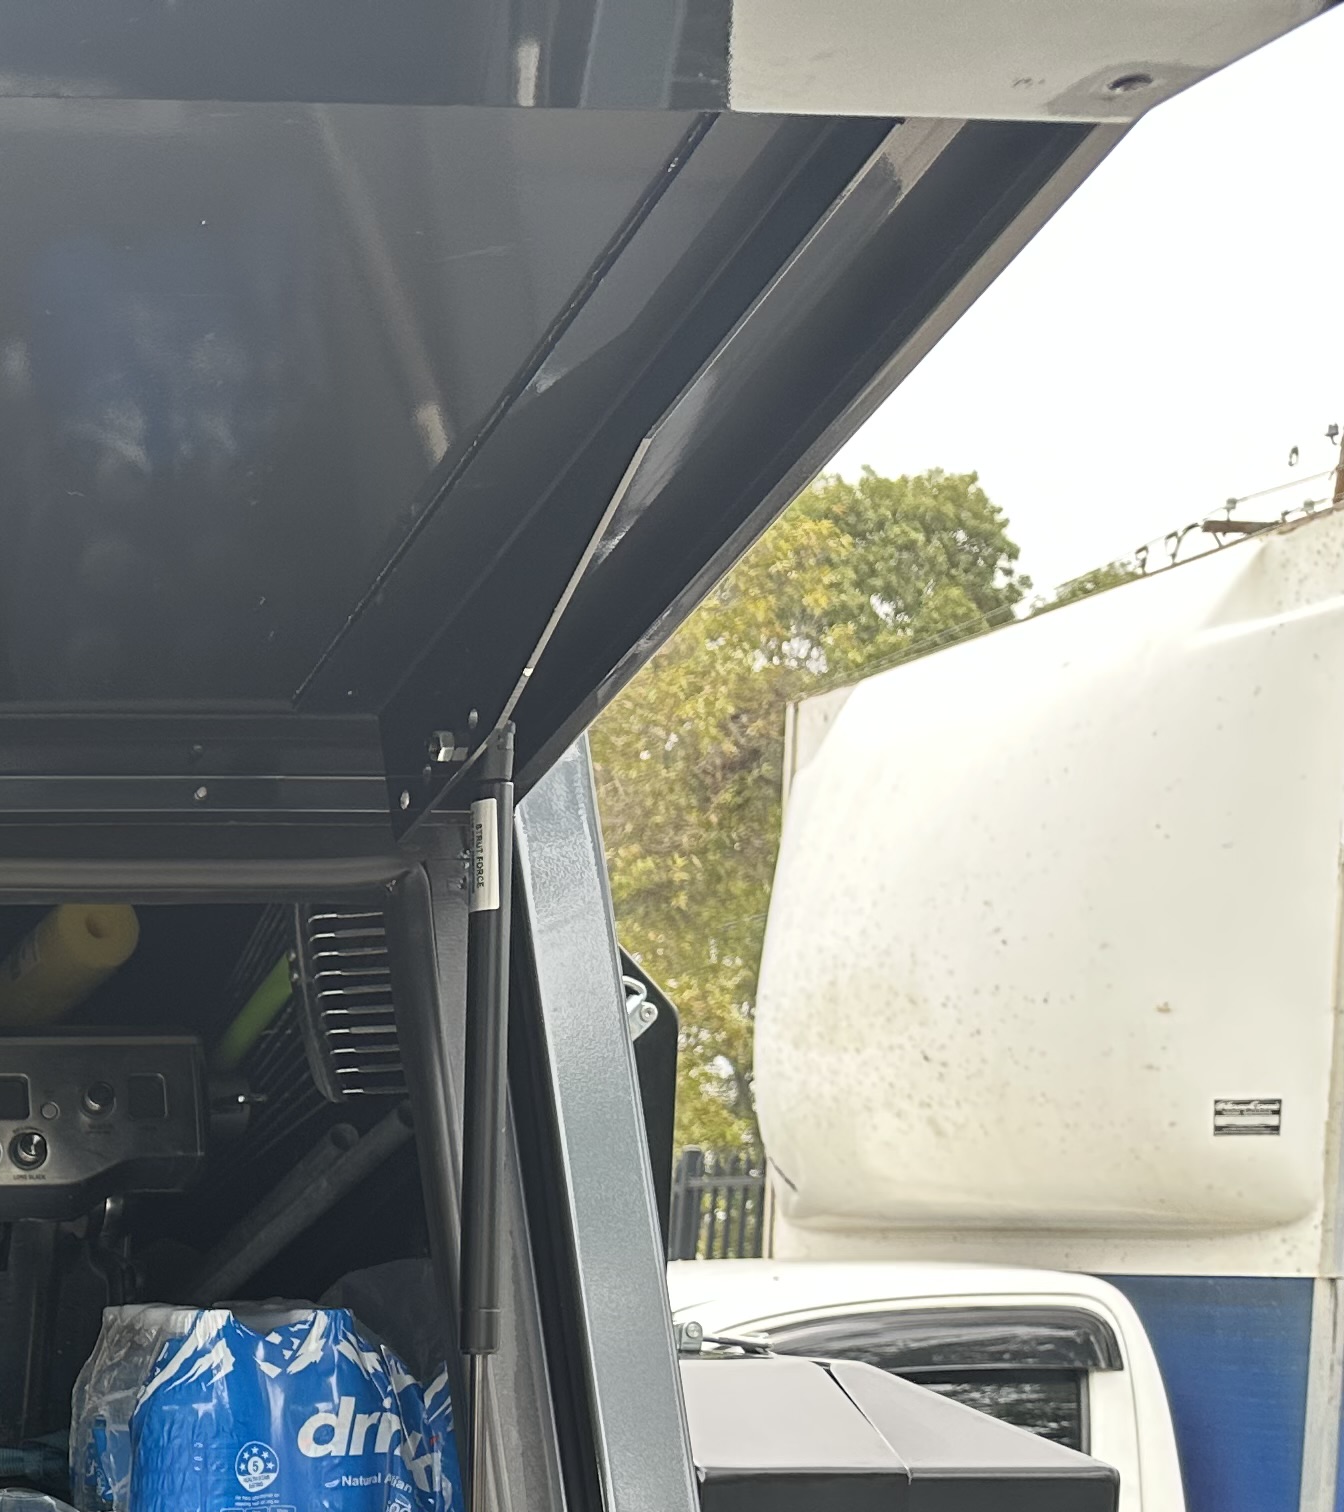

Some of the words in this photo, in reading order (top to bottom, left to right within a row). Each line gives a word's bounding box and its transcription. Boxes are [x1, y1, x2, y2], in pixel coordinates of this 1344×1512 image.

[476, 856, 484, 888] FORCE
[252, 1461, 259, 1473] 5
[341, 1472, 381, 1487] Natural
